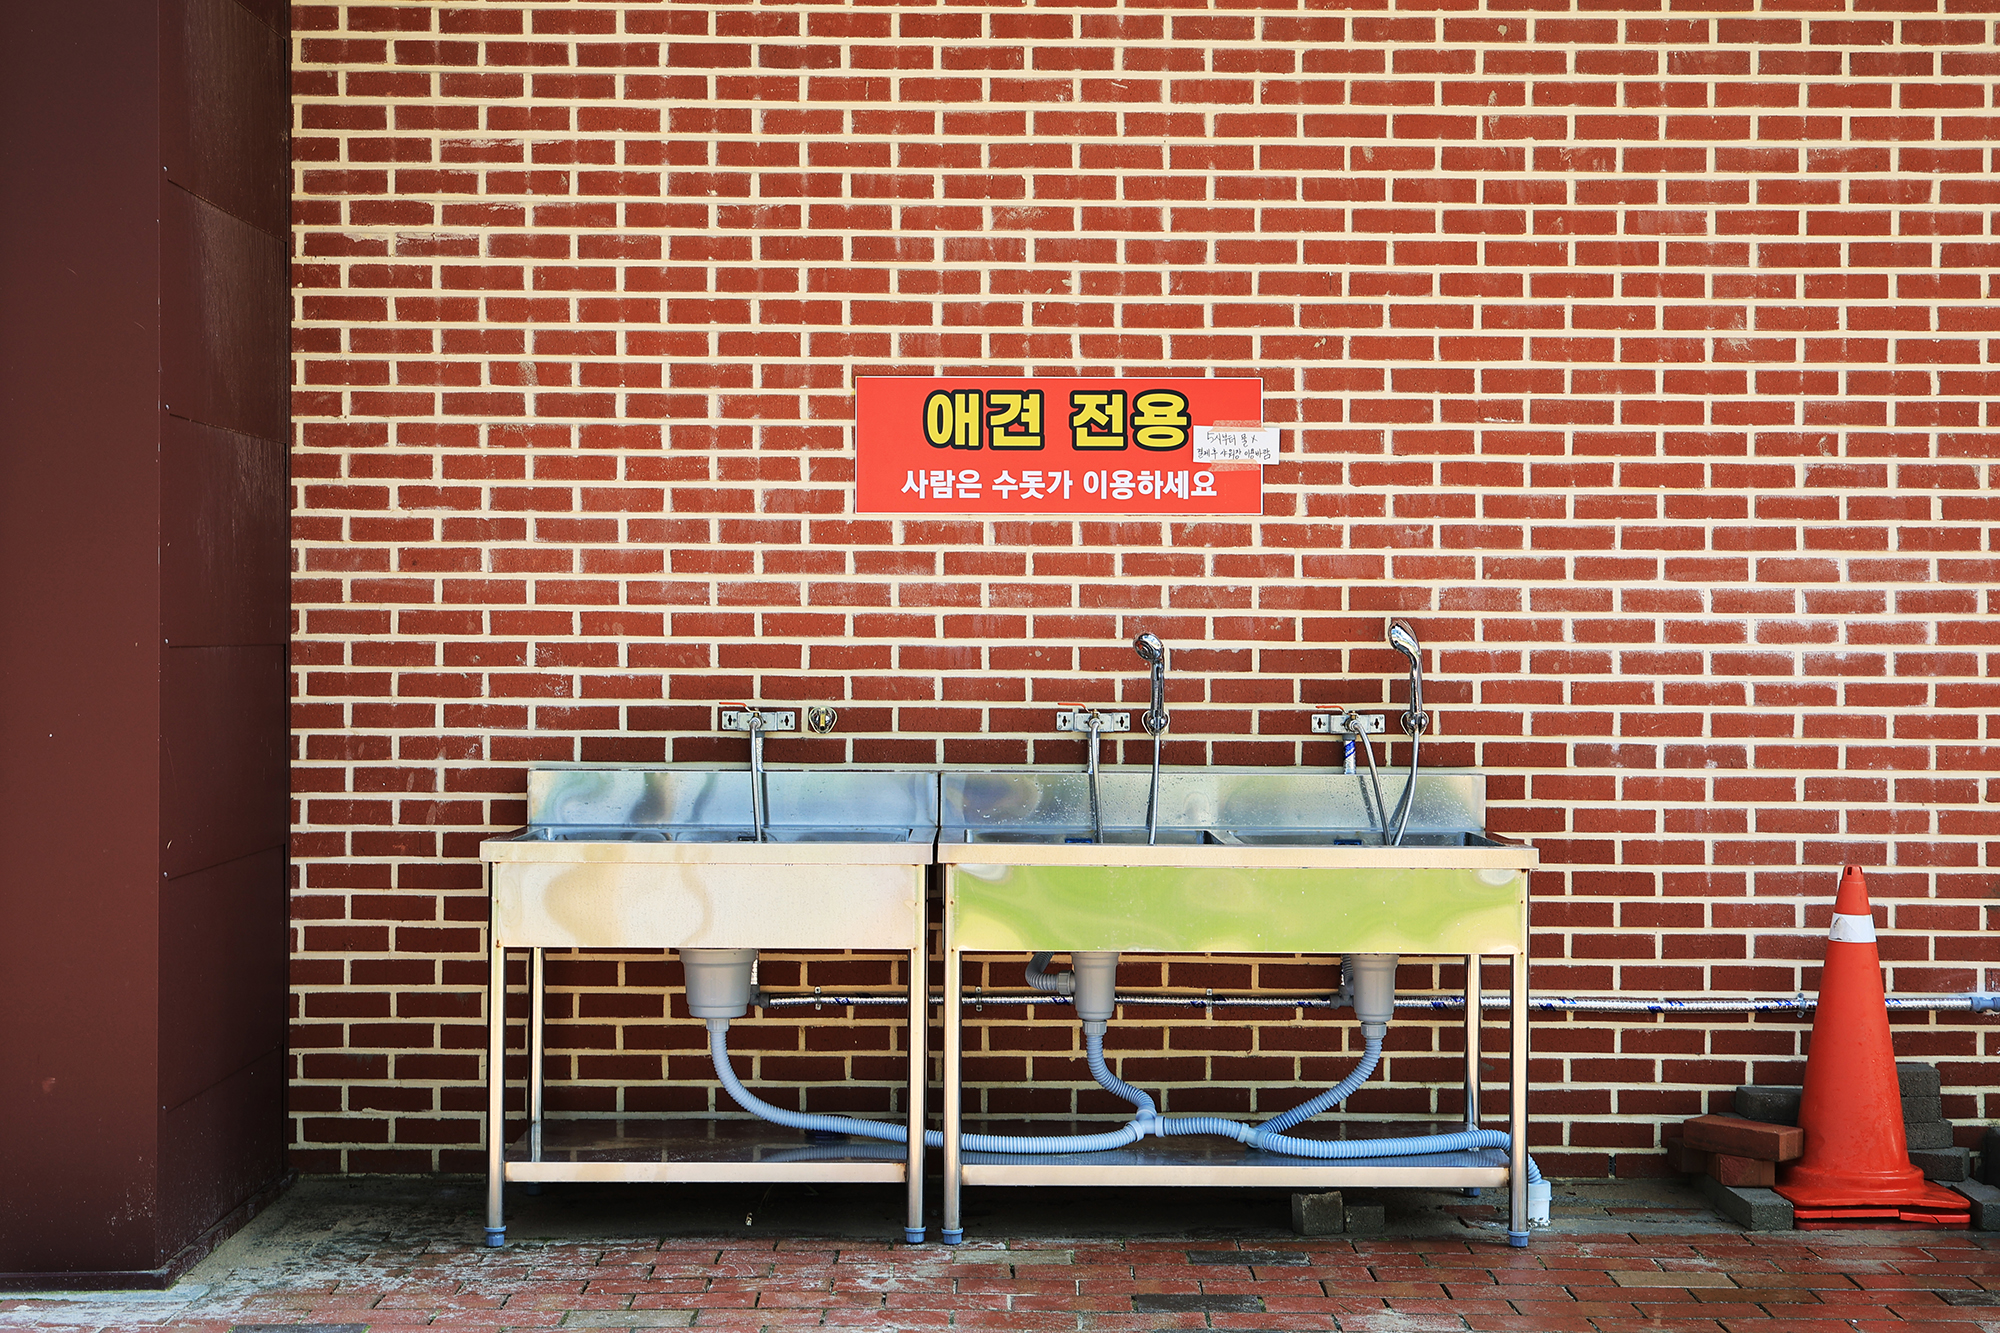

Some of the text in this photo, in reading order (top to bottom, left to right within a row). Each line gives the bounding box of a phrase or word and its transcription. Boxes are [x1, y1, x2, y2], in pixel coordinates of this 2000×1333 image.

[923, 389, 1191, 451] 애견 전용
[900, 469, 1218, 499] 사람은 수돗가 이용하세요
